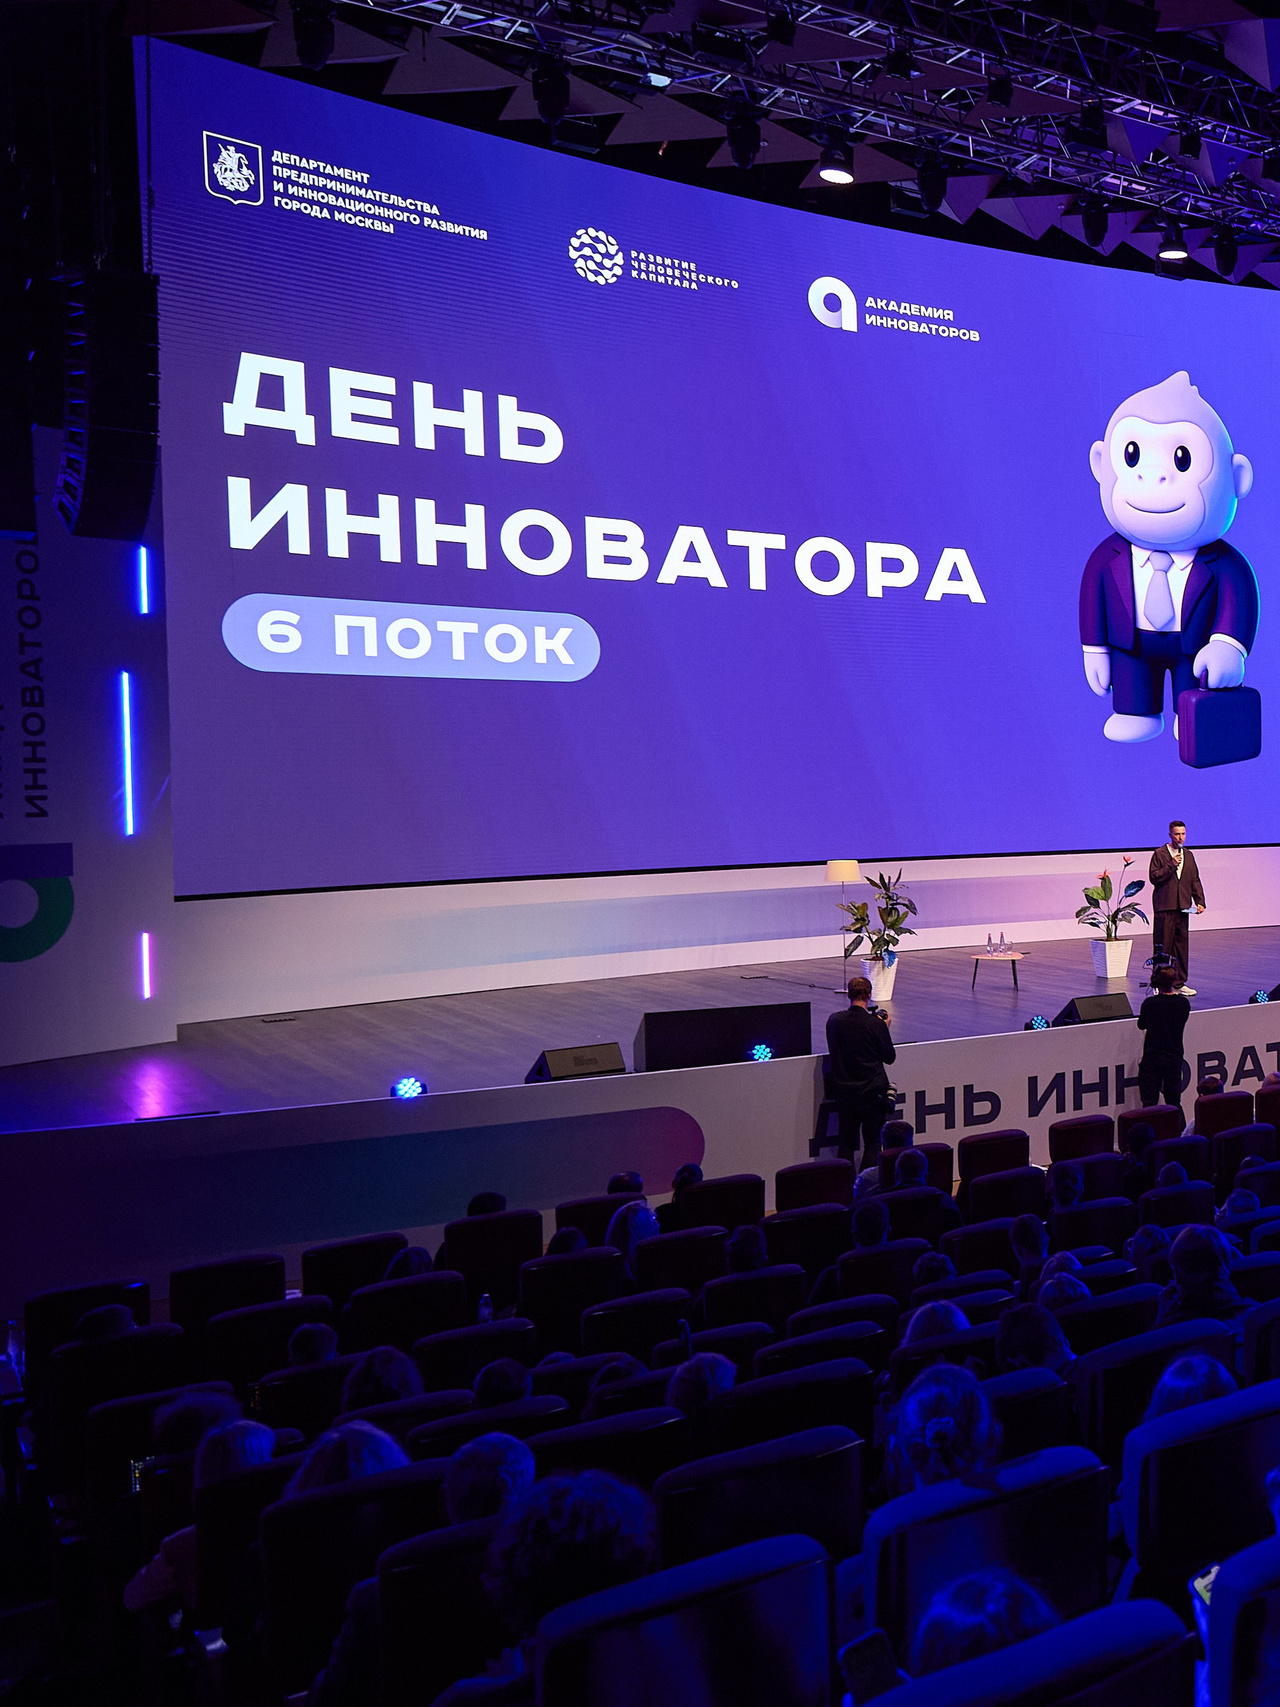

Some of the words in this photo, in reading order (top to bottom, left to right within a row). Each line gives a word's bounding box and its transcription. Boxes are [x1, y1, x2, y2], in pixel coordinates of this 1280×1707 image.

[271, 150, 370, 184] ДЕПАРТАМЕНТ
[272, 165, 440, 216] ПРЕДПРИНИМАТЕЛЬСТВА
[273, 181, 284, 193] И
[288, 184, 421, 225] ИННОВАЦИОННОГО
[423, 216, 488, 241] РАЗВИТИЯ
[273, 196, 331, 219] ГОРОДА
[334, 210, 394, 234] МОСКВЫ
[630, 250, 697, 271] РАЗВИТИЕ
[630, 260, 739, 289] ЧЕЛОВЕЧЕСКОГО
[631, 269, 699, 290] КАПИТАЛА
[865, 296, 954, 321] АКАДЕМИЯ
[865, 313, 981, 342] ИННОВАТОРОВ
[222, 351, 565, 465] ДЕНЬ
[226, 476, 987, 605] ИННОВАТОРА
[256, 609, 303, 653] 6
[334, 614, 575, 667] ПОТОК
[15, 534, 49, 819] ИННОВАТОРО
